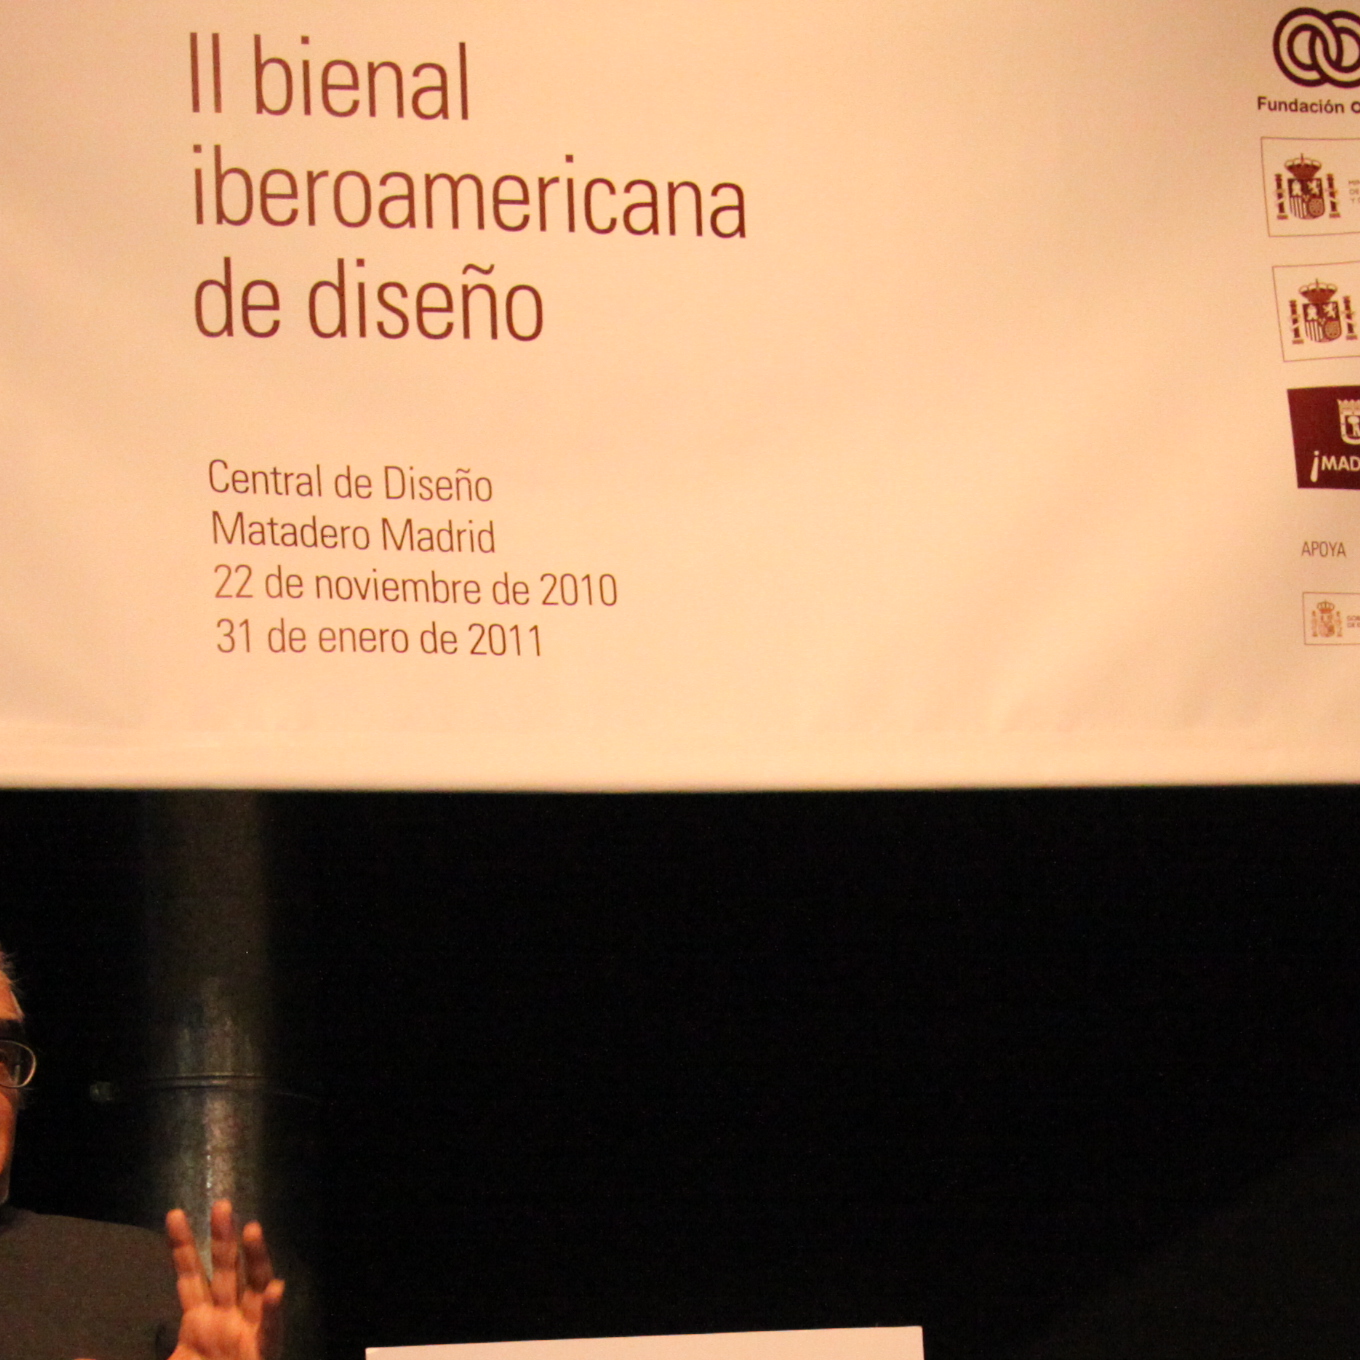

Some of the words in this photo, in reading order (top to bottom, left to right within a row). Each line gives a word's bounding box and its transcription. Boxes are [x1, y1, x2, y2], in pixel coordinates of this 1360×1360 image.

[254, 34, 468, 119] bienal
[1258, 96, 1344, 113] Fundación
[193, 145, 745, 238] iberoamericana
[195, 257, 280, 337] de
[309, 258, 543, 341] diseño
[209, 459, 321, 496] Central
[335, 465, 372, 498] de
[385, 466, 492, 501] Diseño
[213, 511, 369, 549] Matadero
[382, 518, 495, 553] Madrid
[1302, 541, 1346, 557] APOYA
[215, 564, 252, 598] 22
[266, 565, 303, 598] de
[316, 569, 480, 604] noviembre
[493, 572, 529, 605] de
[540, 573, 617, 606] 2010
[217, 618, 250, 653] 31
[268, 618, 306, 653] de
[319, 628, 409, 653] enero
[420, 621, 457, 654] de
[469, 623, 540, 656] 2011
